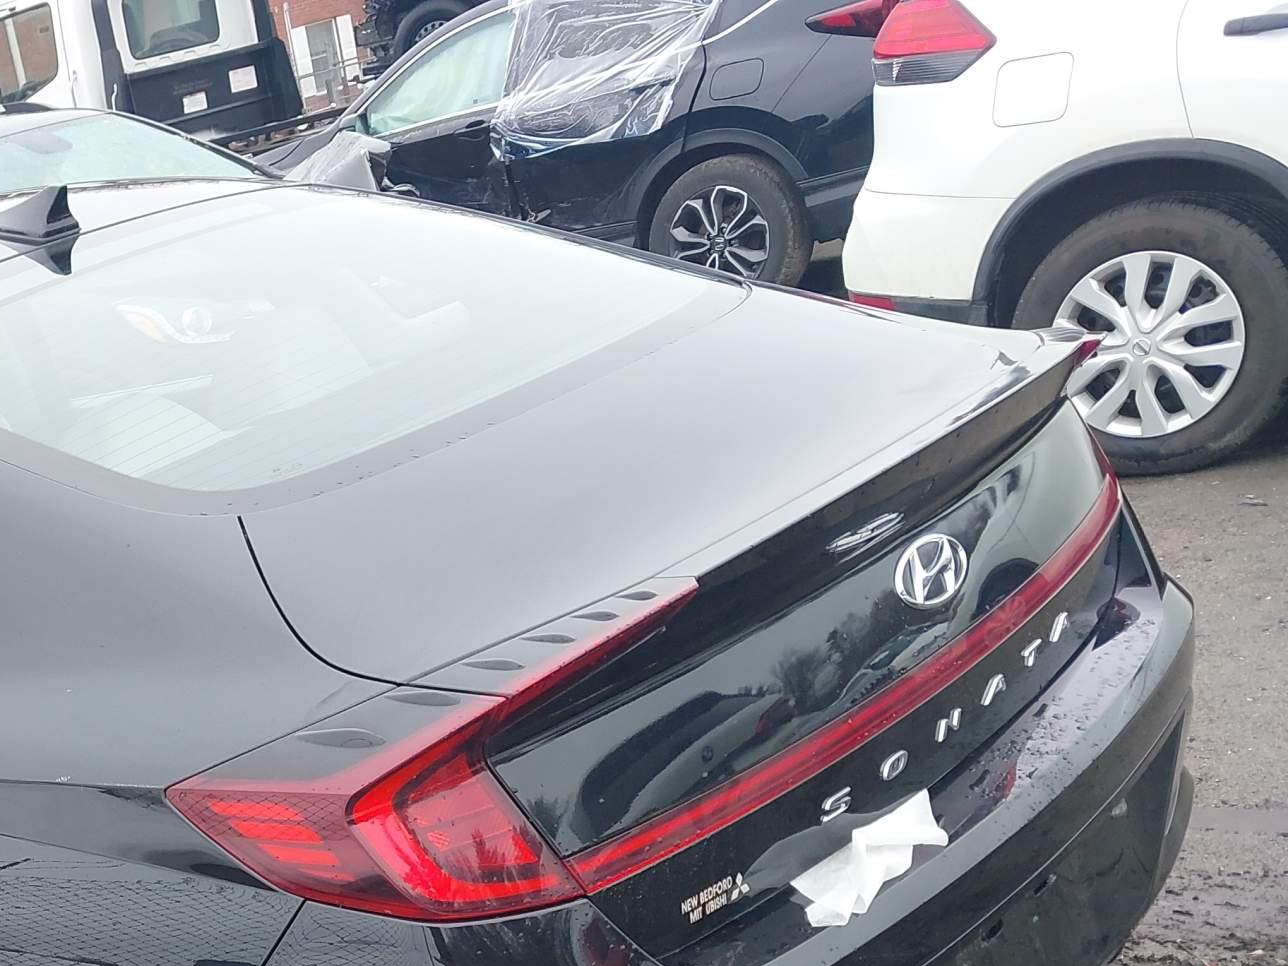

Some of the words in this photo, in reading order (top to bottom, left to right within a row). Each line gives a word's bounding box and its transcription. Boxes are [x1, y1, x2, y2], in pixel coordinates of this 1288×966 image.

[820, 612, 1069, 823] SONATA
[681, 894, 698, 914] NEW
[700, 876, 732, 904] BEDFORD
